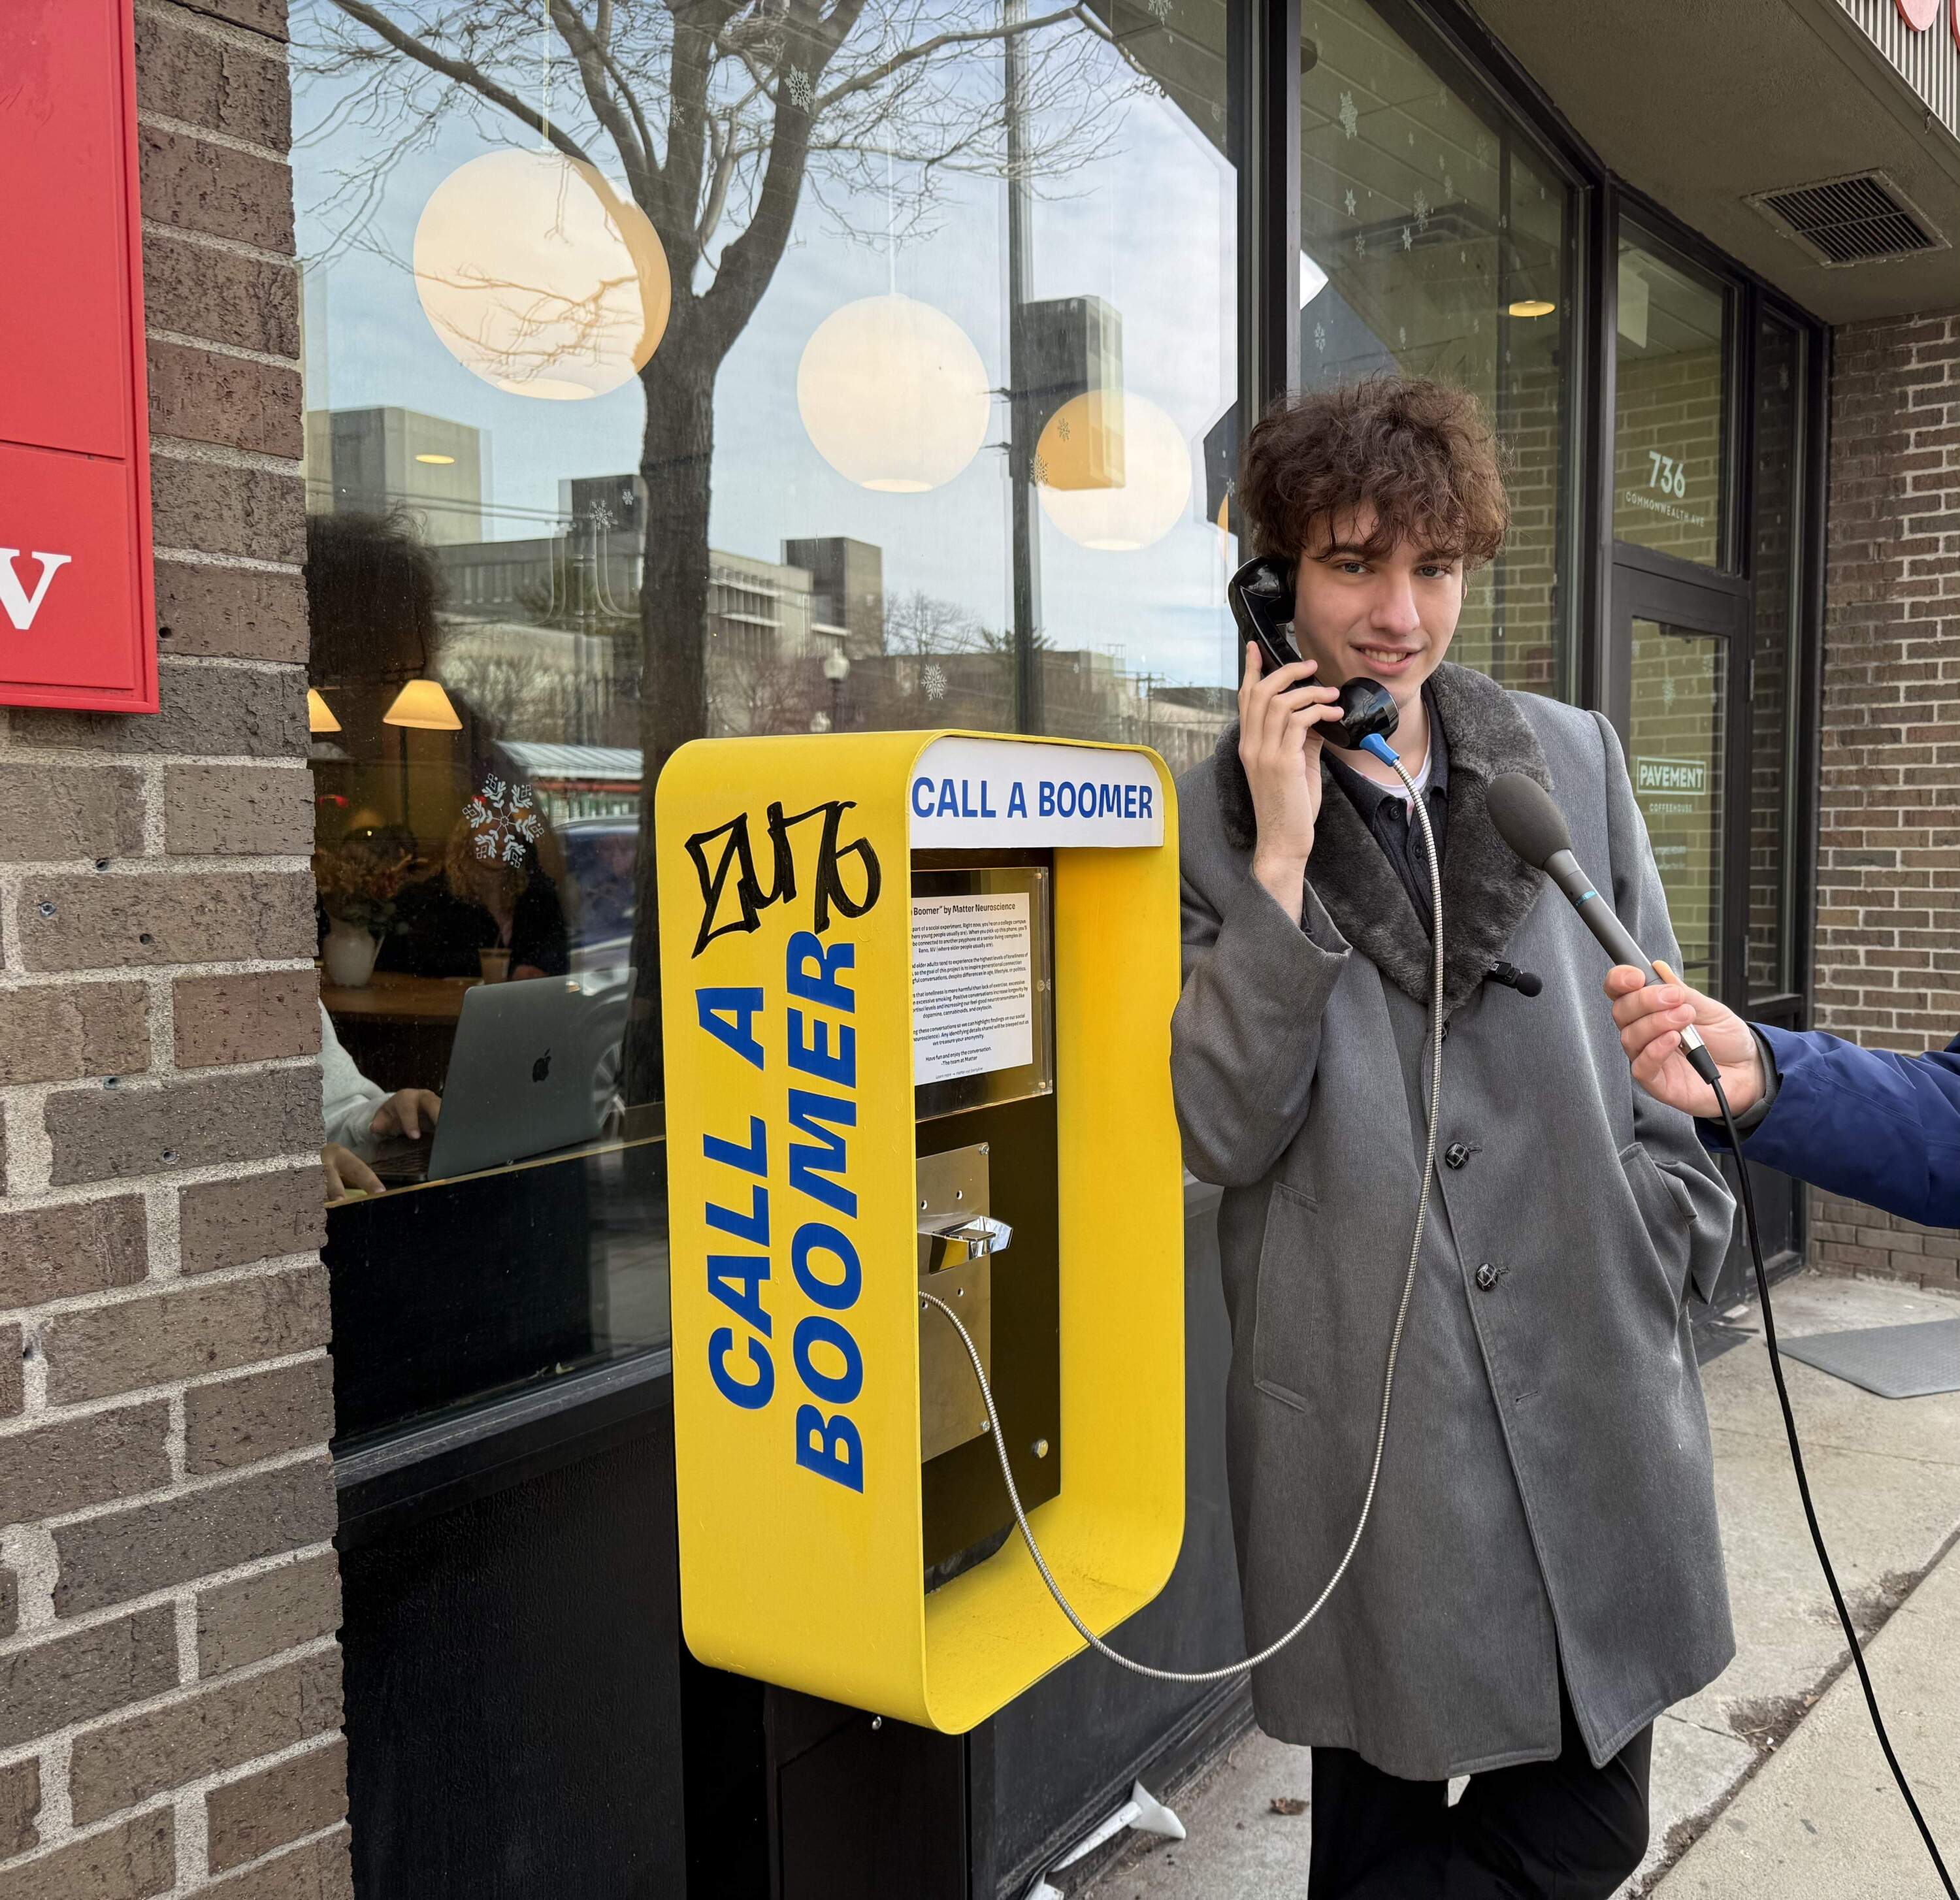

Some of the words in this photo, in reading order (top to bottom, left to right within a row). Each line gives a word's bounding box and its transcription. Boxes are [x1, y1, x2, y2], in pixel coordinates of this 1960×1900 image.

[1649, 450, 1686, 499] 736
[1625, 491, 1689, 523] COMMONWEALTH
[1691, 516, 1705, 527] AVE
[1640, 764, 1703, 788] PAVEMENT
[912, 777, 996, 818] CALL
[1007, 782, 1028, 818] A
[1039, 781, 1152, 819] BOOMER
[1649, 803, 1693, 813] COFFEEHOUSE
[944, 906, 951, 915] by
[975, 902, 1015, 911] Neuroscience
[696, 987, 764, 1072] A
[787, 930, 864, 1495] BOOMER
[704, 1115, 776, 1410] CALL
